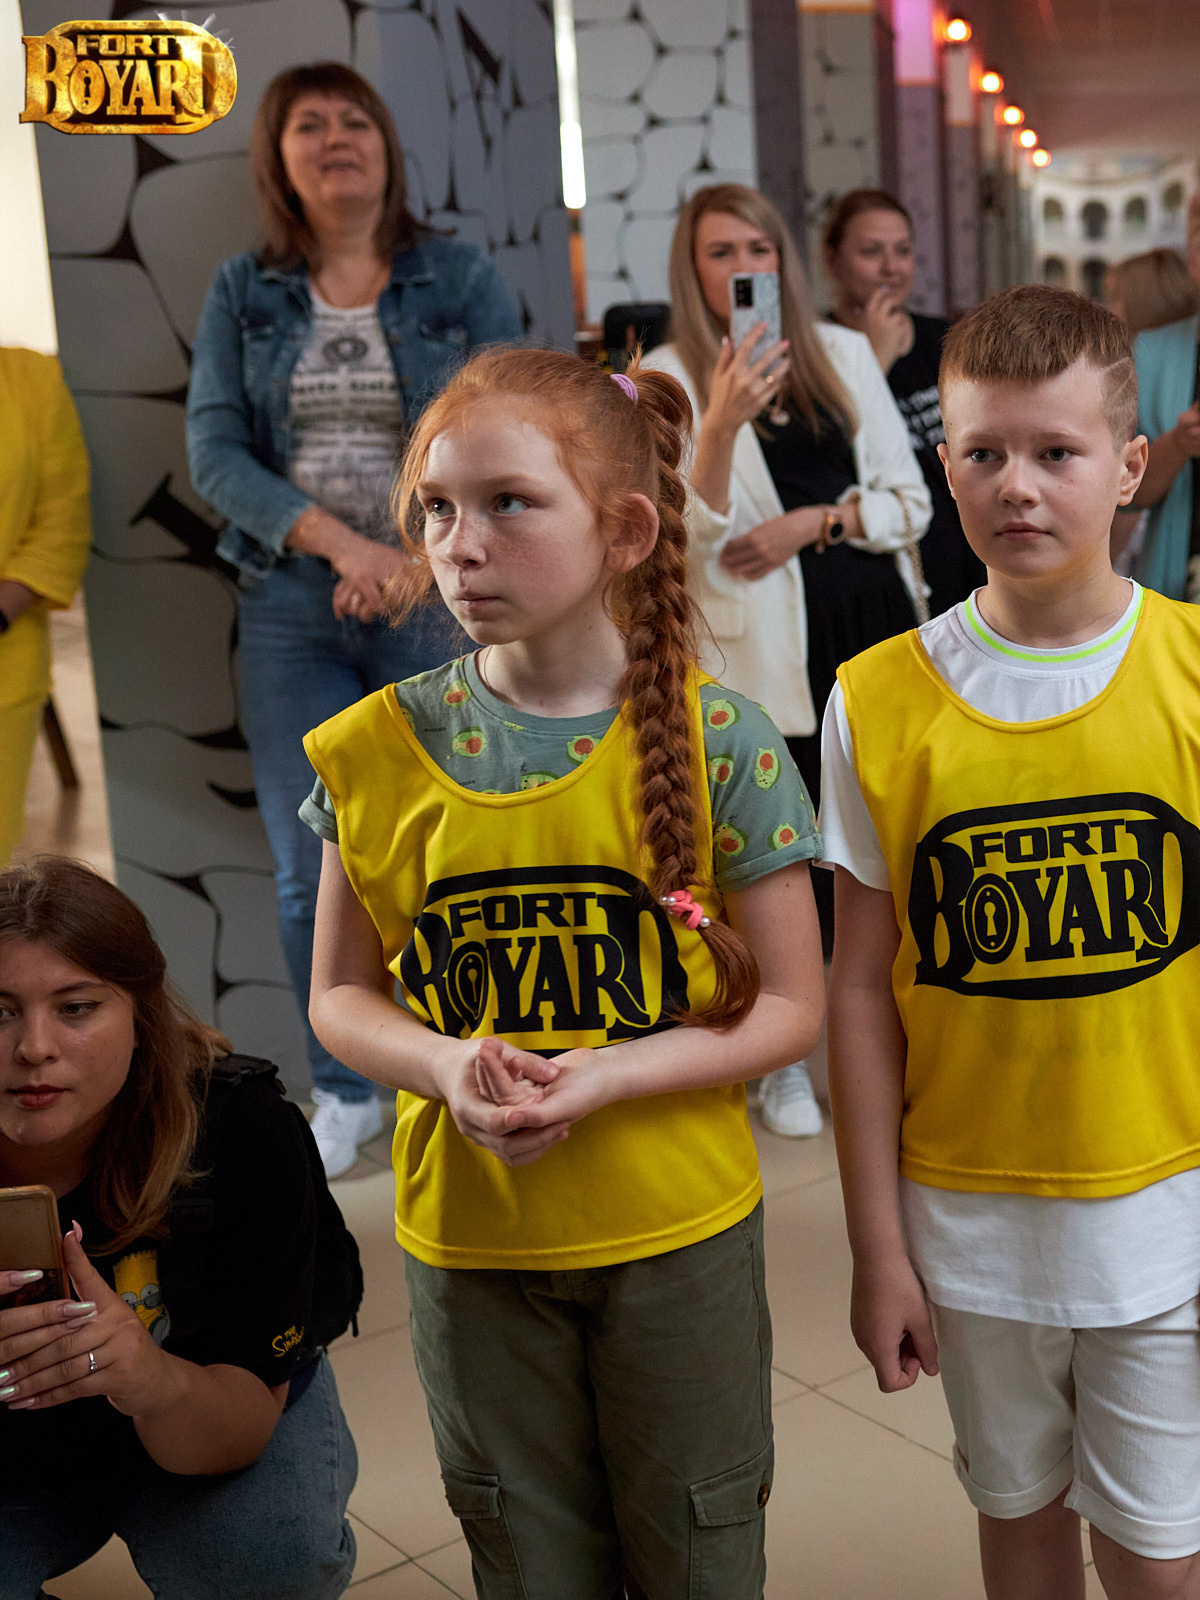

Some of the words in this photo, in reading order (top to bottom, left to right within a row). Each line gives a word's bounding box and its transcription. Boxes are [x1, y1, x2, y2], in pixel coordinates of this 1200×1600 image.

[970, 818, 1126, 868] FORT
[448, 891, 597, 940] FORT
[400, 893, 690, 1042] BOYARD
